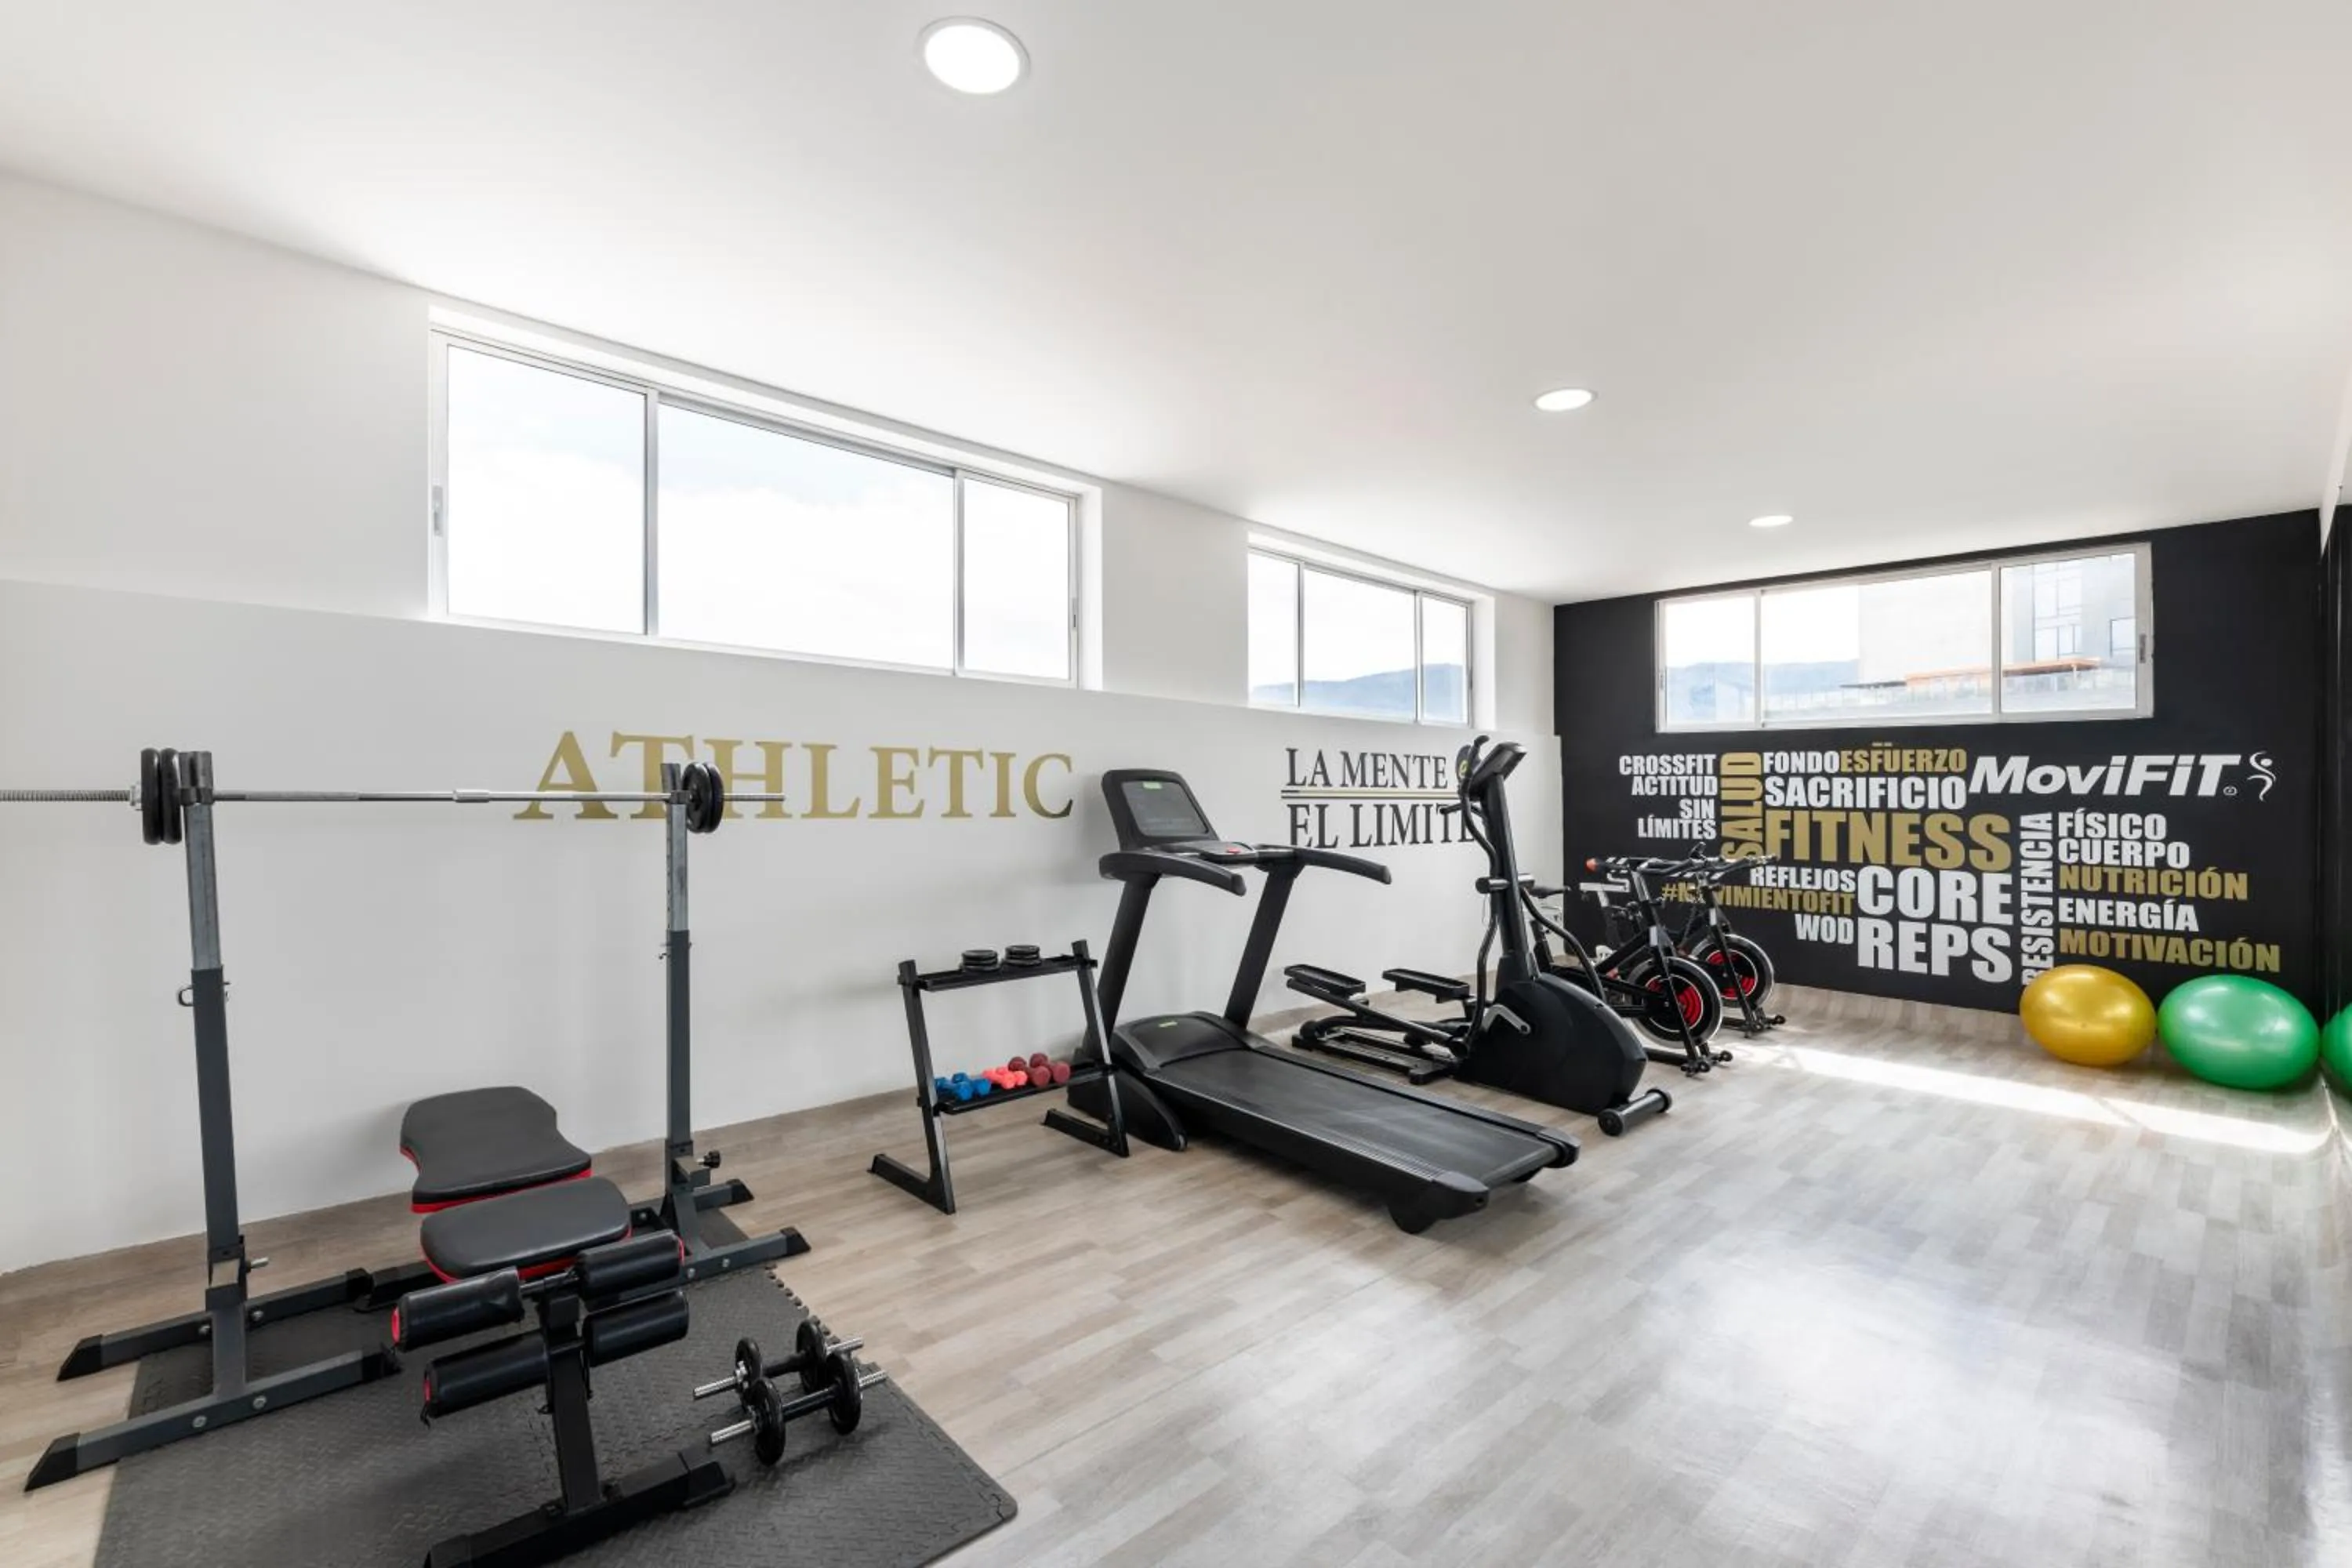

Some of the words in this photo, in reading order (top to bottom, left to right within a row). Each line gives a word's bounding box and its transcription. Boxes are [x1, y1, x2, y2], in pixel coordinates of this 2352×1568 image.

[513, 730, 1073, 821] ATHLETIC
[1285, 748, 1333, 788] LA
[1339, 750, 1448, 789] MENTE
[1619, 753, 1716, 775] CROSSFIT
[1763, 751, 1840, 774] FONDO
[1841, 748, 1966, 773] ESFUERZO
[1632, 775, 1718, 796] ACTITUD
[1765, 776, 1966, 810] SACRIFICIO
[1679, 798, 1715, 820] SIN
[1720, 752, 1764, 861] SALUD
[1287, 804, 1338, 848] EL
[1638, 815, 1717, 840] LÍMITES
[1765, 810, 2012, 873] FITNESS
[2058, 808, 2167, 841] FÍSICO
[2058, 837, 2190, 869] CUERPO
[1750, 866, 1856, 893] REFLEJOS
[1857, 866, 2013, 926] CORE
[2059, 865, 2248, 902] NUTRICIÓN
[1795, 913, 1854, 945] WOD
[2059, 898, 2199, 932] ENERGÍA
[1857, 916, 2013, 984] REPS
[2060, 927, 2280, 973] MOTIVACIÓN
